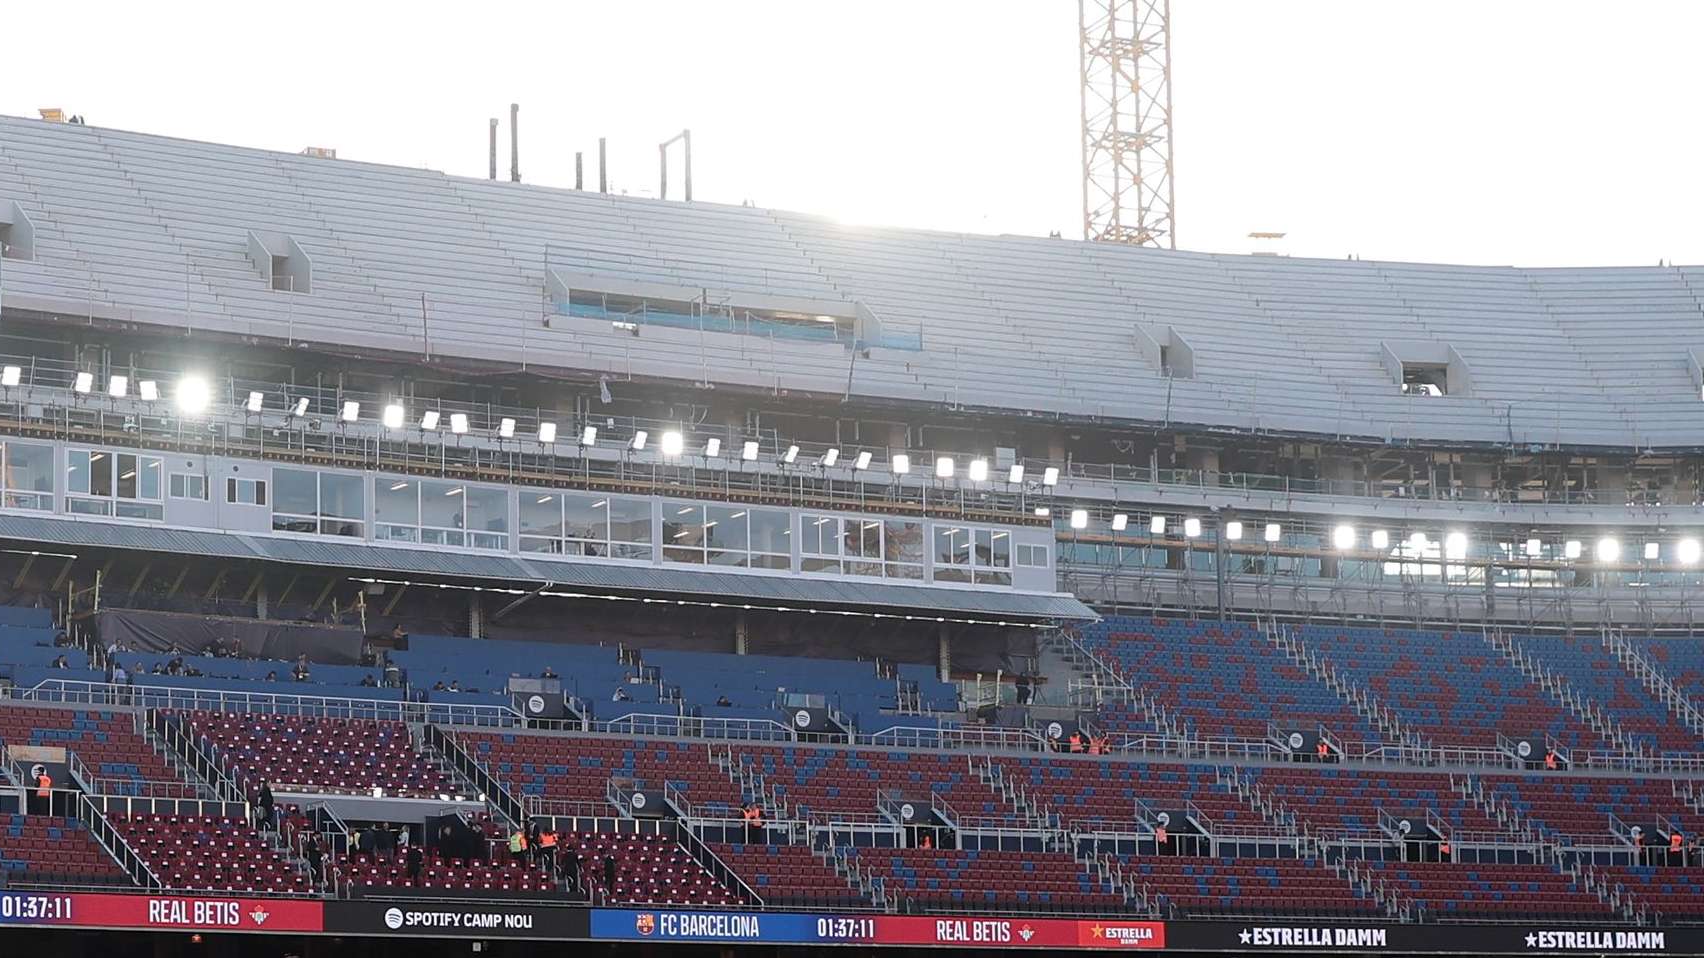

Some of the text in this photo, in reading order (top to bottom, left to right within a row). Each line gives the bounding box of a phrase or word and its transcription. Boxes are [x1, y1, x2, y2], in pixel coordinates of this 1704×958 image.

[2, 896, 71, 918] 01:37:11
[149, 899, 240, 925] REAL BETIS
[405, 911, 533, 929] SPOTIFY CAMP NOU
[660, 914, 760, 937] FC BARCELONA
[817, 918, 874, 938] 01:37:11
[936, 920, 1011, 942] REAL BETIS
[1105, 927, 1153, 939] ESTRELLA
[1252, 927, 1387, 947] ESTRELLA DAMM
[1538, 931, 1665, 949] ESTRELLA DAMM
